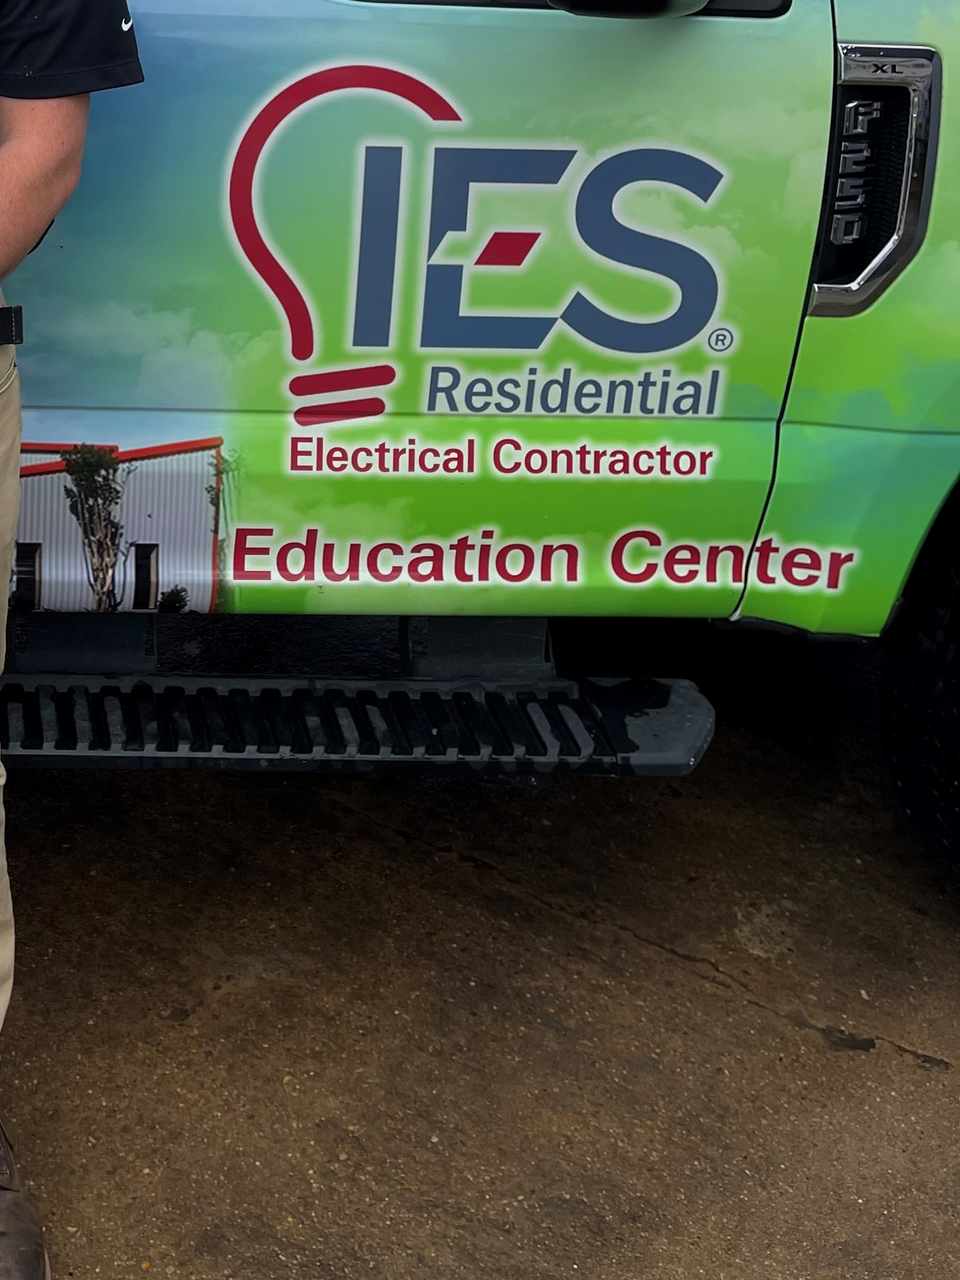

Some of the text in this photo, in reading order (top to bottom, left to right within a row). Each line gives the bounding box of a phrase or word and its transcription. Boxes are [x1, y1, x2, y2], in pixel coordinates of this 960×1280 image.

[871, 63, 904, 74] XL
[352, 145, 724, 354] IES
[426, 365, 722, 416] Residential
[289, 436, 714, 476] Electrical Contractor
[232, 527, 855, 590] Education Center
